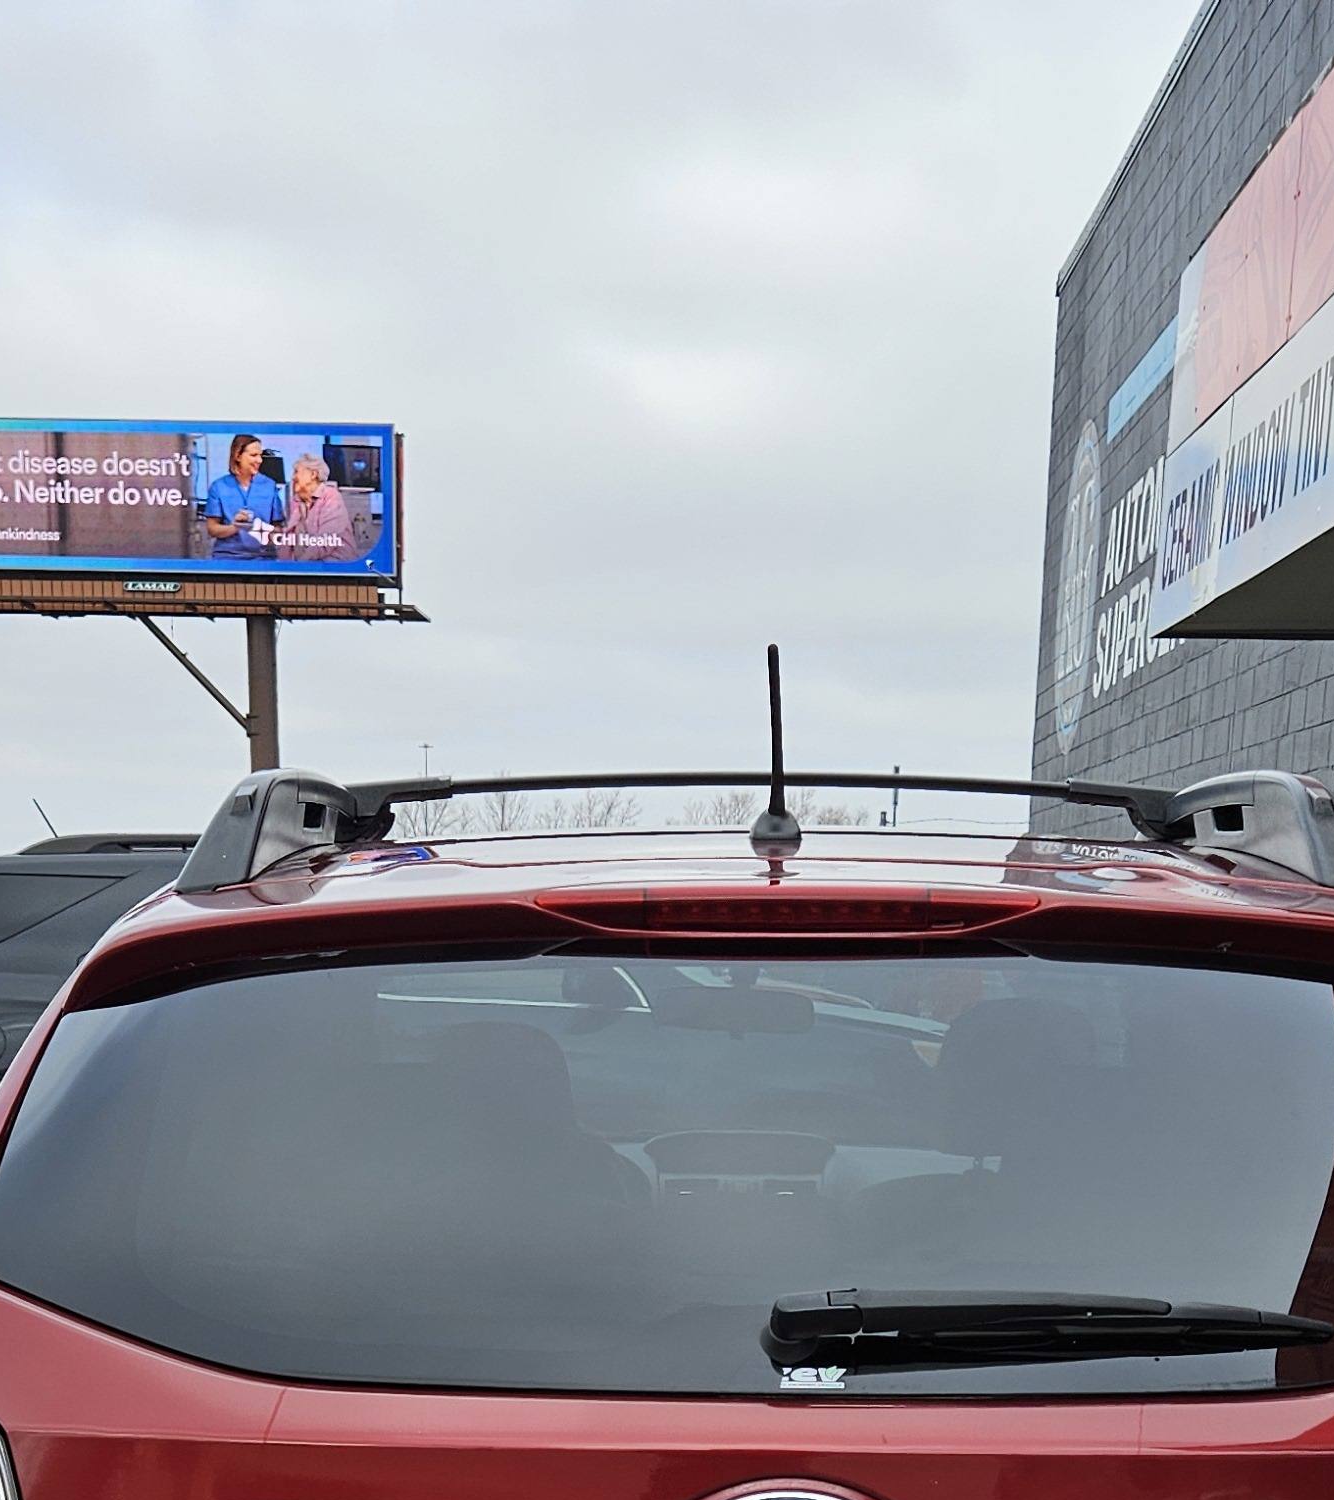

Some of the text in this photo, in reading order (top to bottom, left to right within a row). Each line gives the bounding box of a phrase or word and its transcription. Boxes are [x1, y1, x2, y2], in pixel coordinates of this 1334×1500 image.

[8, 450, 97, 476] disease
[102, 451, 190, 477] doesn't
[14, 480, 106, 505] Neither
[108, 481, 140, 506] do
[144, 487, 189, 507] we.
[1162, 458, 1220, 591] CERAMIC
[1219, 392, 1296, 549] WINDOW
[273, 532, 343, 548] CHI Health
[127, 581, 175, 591] LAMAR
[1092, 576, 1186, 699] SUPER
